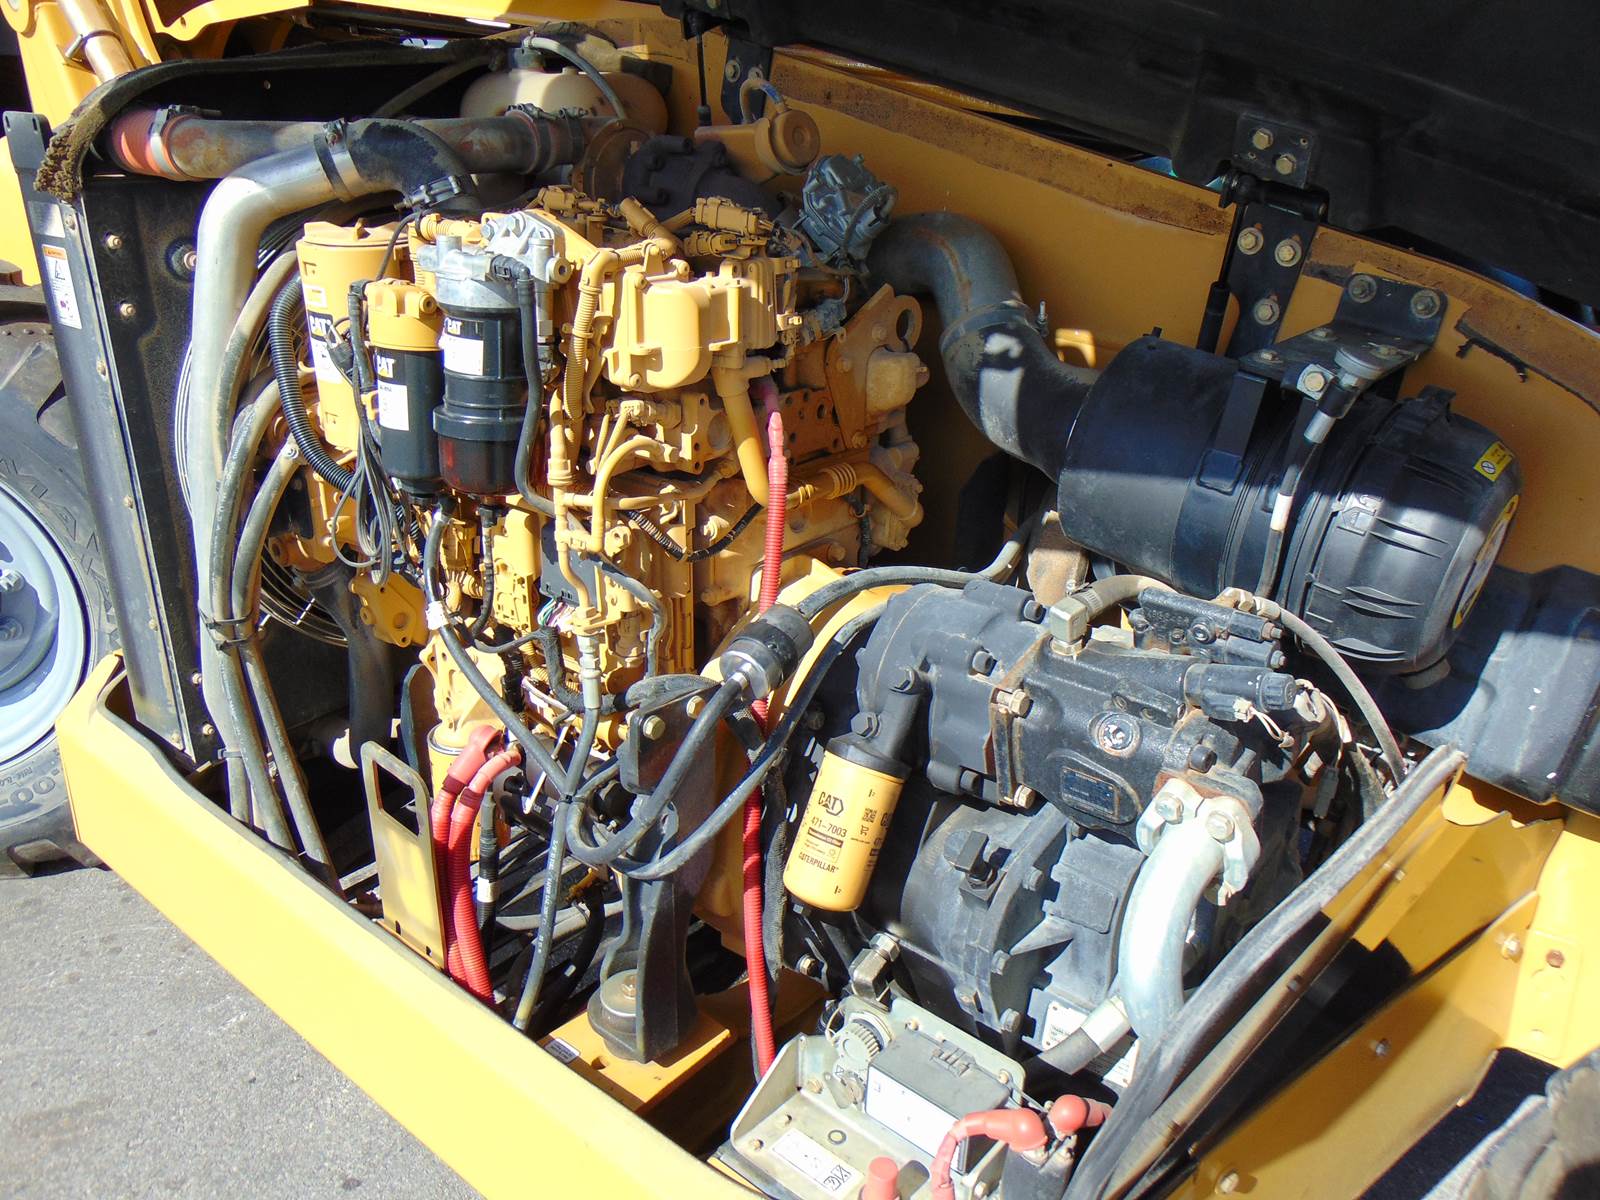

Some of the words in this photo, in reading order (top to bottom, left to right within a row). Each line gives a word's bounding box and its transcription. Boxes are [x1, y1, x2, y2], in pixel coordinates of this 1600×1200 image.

[818, 790, 845, 817] CAT
[811, 816, 848, 838] 471-7003
[798, 851, 837, 873] CATERPILLAR
